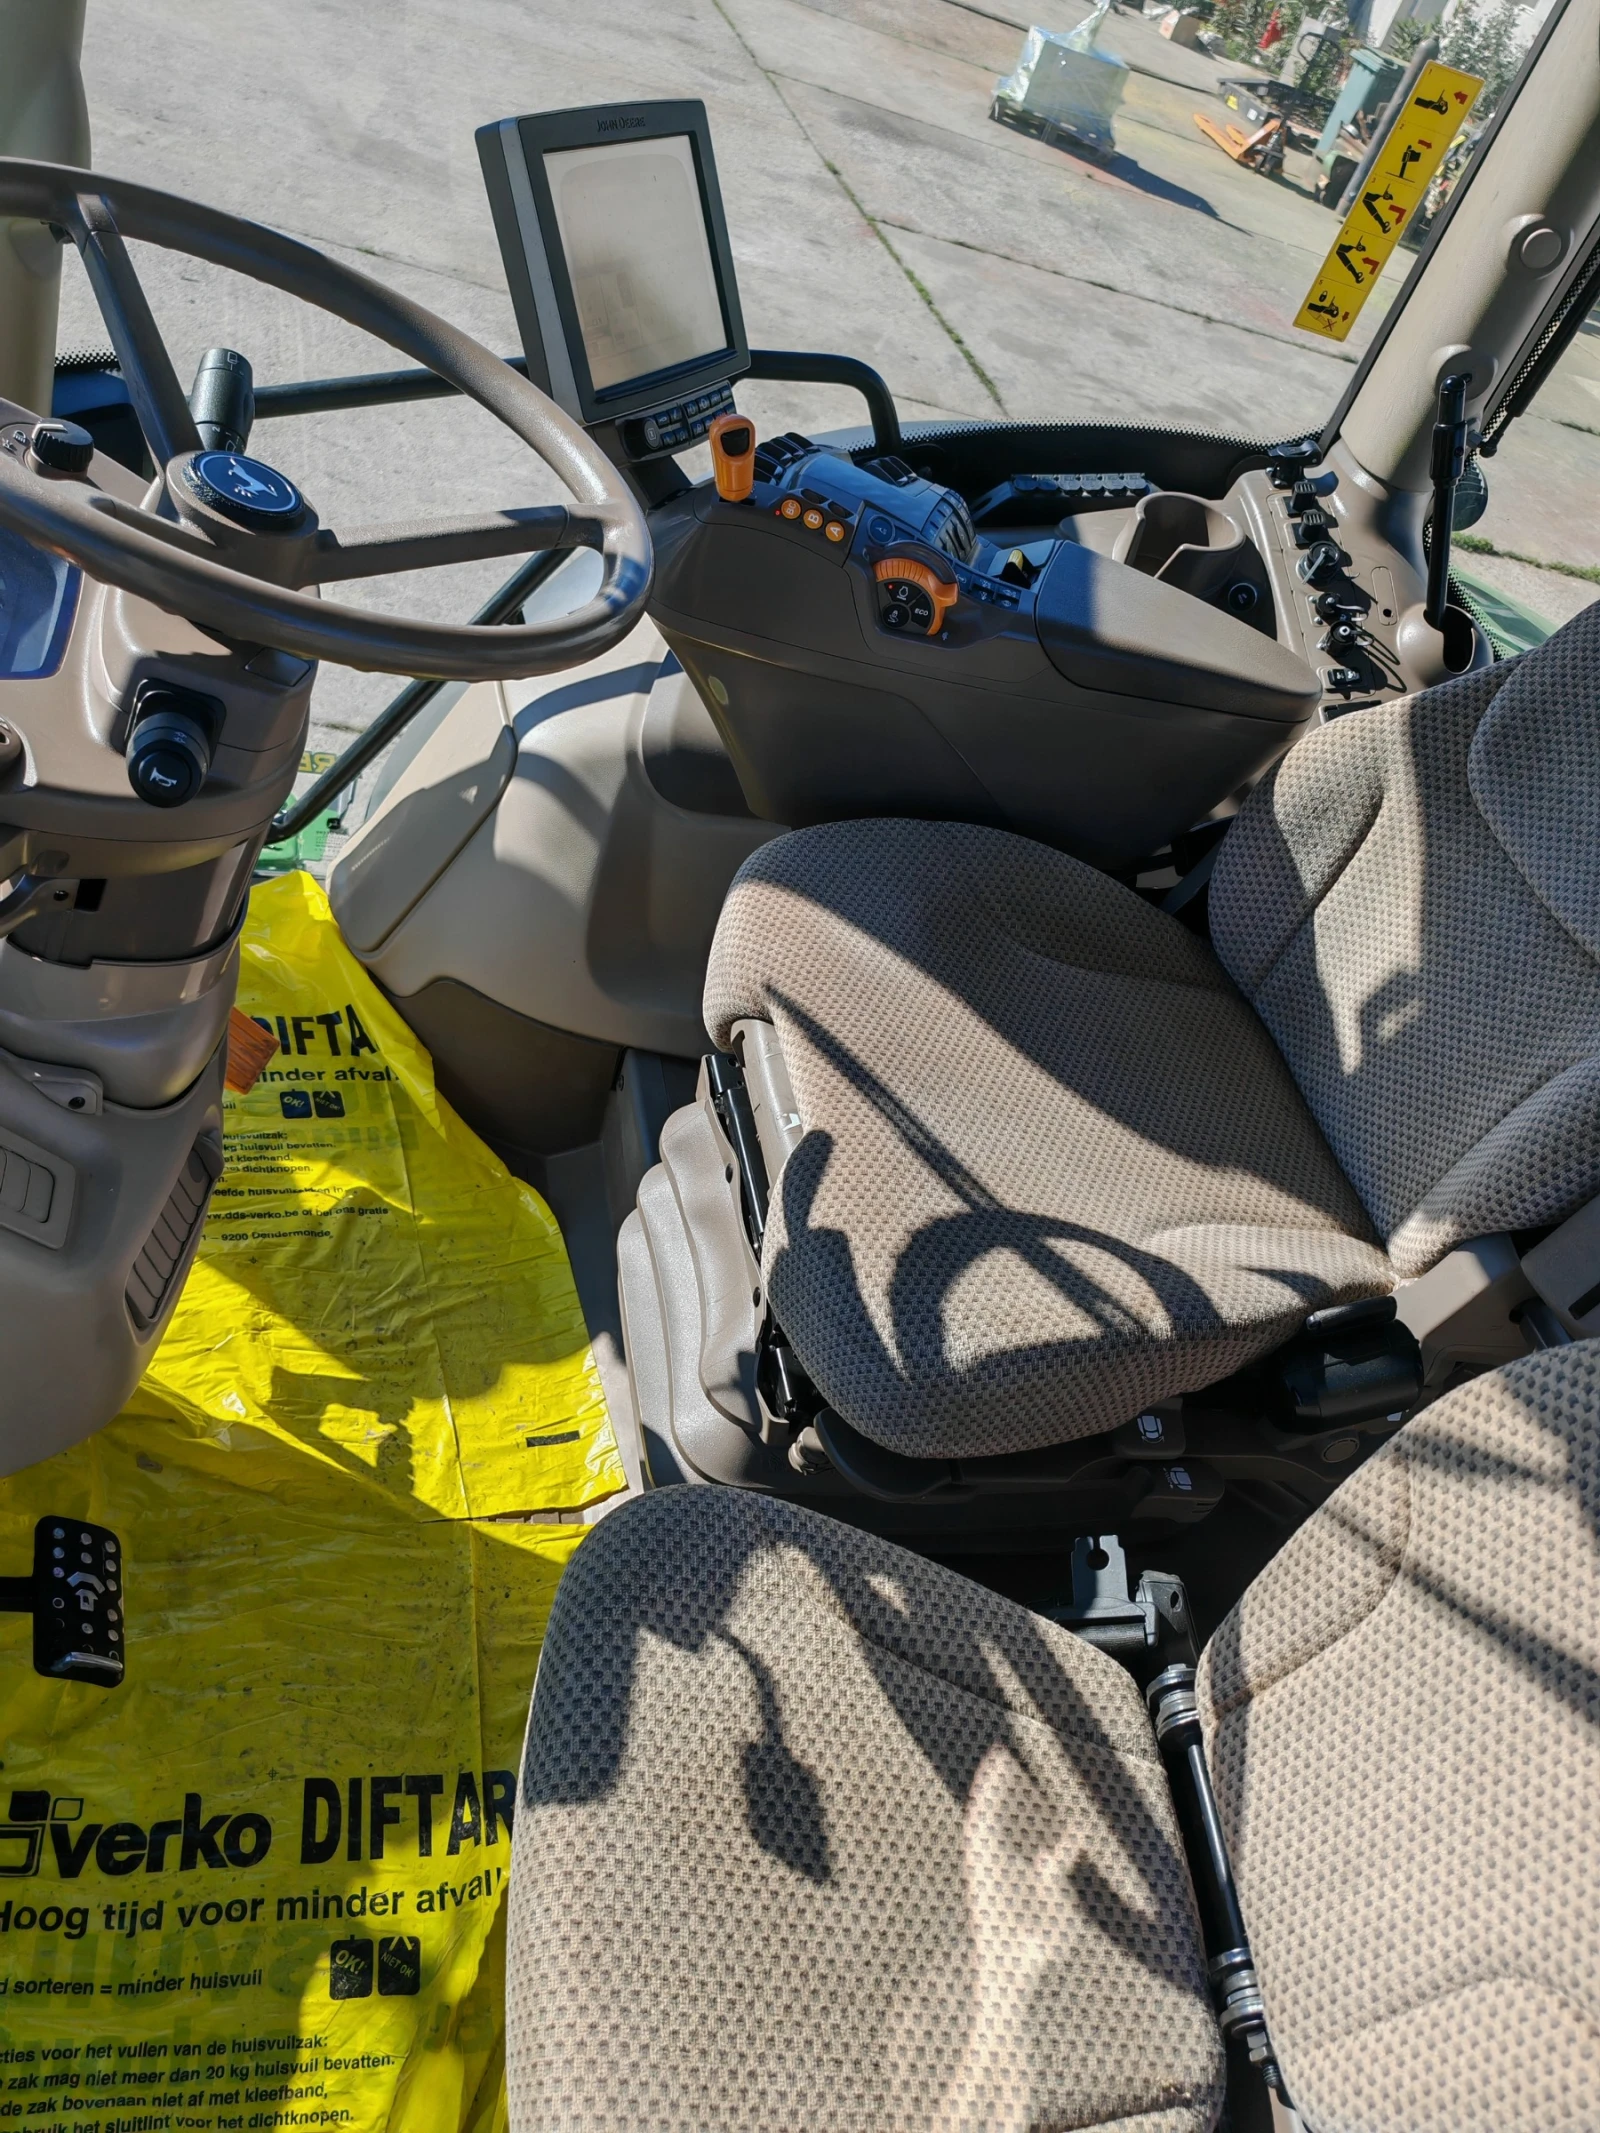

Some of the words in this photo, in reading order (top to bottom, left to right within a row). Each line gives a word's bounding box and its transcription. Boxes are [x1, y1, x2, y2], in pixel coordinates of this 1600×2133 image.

[597, 118, 619, 132] JOHN
[619, 116, 646, 129] DEERE
[808, 513, 820, 525] B
[829, 525, 842, 538] A
[914, 607, 929, 616] ECO
[250, 1004, 379, 1057] IFTA
[256, 1067, 326, 1083] inder
[283, 1096, 305, 1108] OK!
[242, 1164, 314, 1174] dichtknopen.
[358, 1206, 389, 1216] gratis
[221, 1233, 249, 1241] 9200
[50, 1793, 272, 1879] verko
[301, 1770, 518, 1865] DIFTAR
[103, 1900, 164, 1938] tijd
[177, 1897, 265, 1928] voor
[277, 1886, 404, 1921] minder
[335, 1949, 366, 1975] OK!
[381, 1951, 402, 1969] NIET
[400, 1964, 416, 1978] OK!
[13, 1977, 94, 1995] sorteren
[118, 1975, 185, 1996] minder
[190, 1969, 263, 1990] huisvuil
[42, 2048, 81, 2060] voor
[86, 2044, 113, 2059] het
[118, 2042, 167, 2058] vullen
[173, 2043, 201, 2056] van
[207, 2040, 227, 2055] de
[232, 2034, 328, 2054] huisvuilzak:
[8, 2073, 40, 2090] zak
[44, 2073, 80, 2088] mag
[86, 2070, 118, 2086] niet
[122, 2071, 165, 2085] meer
[170, 2067, 200, 2082] dan
[205, 2065, 226, 2079] 20
[230, 2064, 250, 2081] kg
[254, 2059, 319, 2077] huisvuil
[324, 2055, 395, 2071] bevatten.
[1, 2100, 23, 2117] de
[27, 2097, 58, 2115] zak
[62, 2095, 147, 2111] bovenaan
[152, 2093, 184, 2107] niet
[188, 2091, 205, 2106] af
[208, 2090, 241, 2106] met
[245, 2082, 328, 2104] kleefband,
[73, 2120, 101, 2133] het
[105, 2115, 171, 2133] sluitlint
[176, 2115, 212, 2129] voor
[217, 2113, 244, 2129] het
[248, 2109, 355, 2129] dichtknopen.
